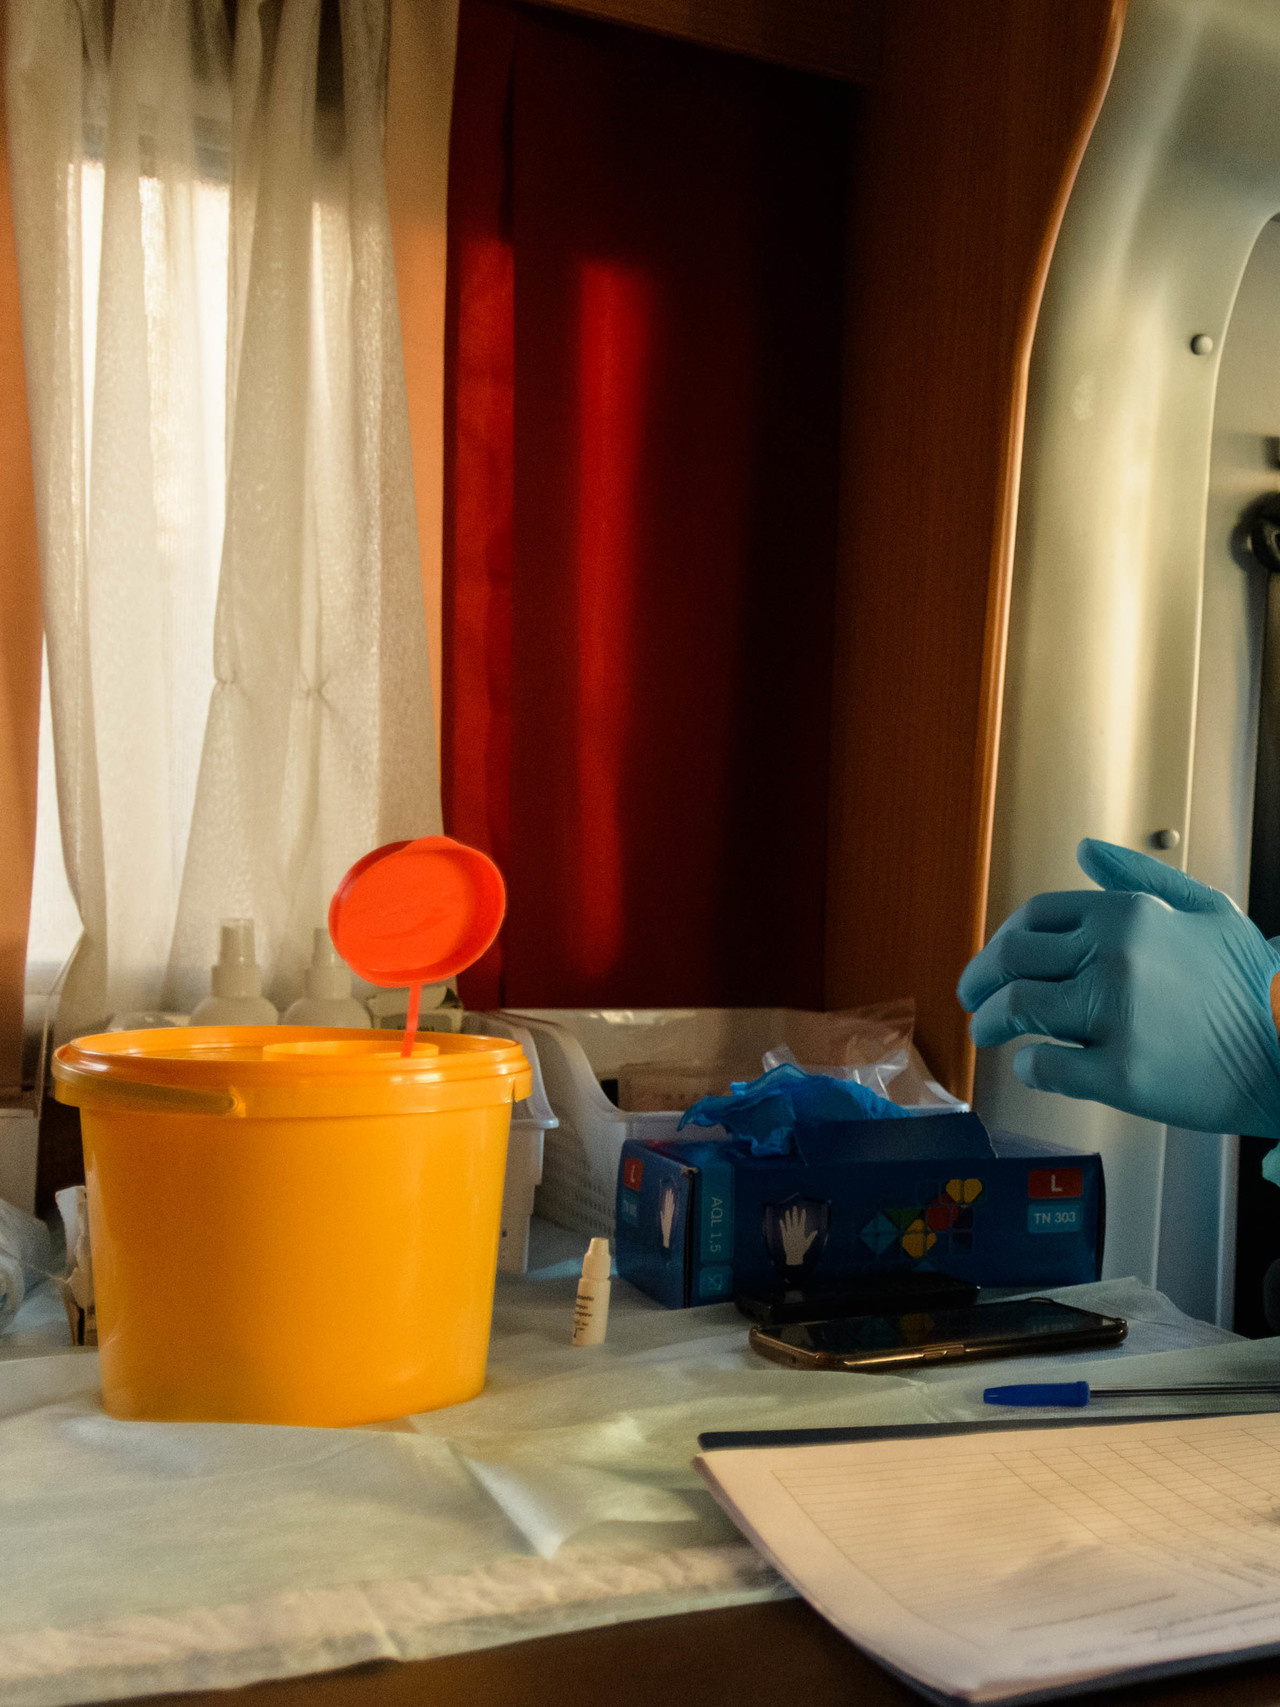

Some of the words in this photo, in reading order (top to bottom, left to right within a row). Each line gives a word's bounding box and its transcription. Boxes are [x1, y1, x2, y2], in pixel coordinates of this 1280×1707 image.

[1050, 1174, 1063, 1192] L
[711, 1196, 723, 1228] AQL
[1035, 1213, 1051, 1224] TN
[1055, 1212, 1076, 1223] 303
